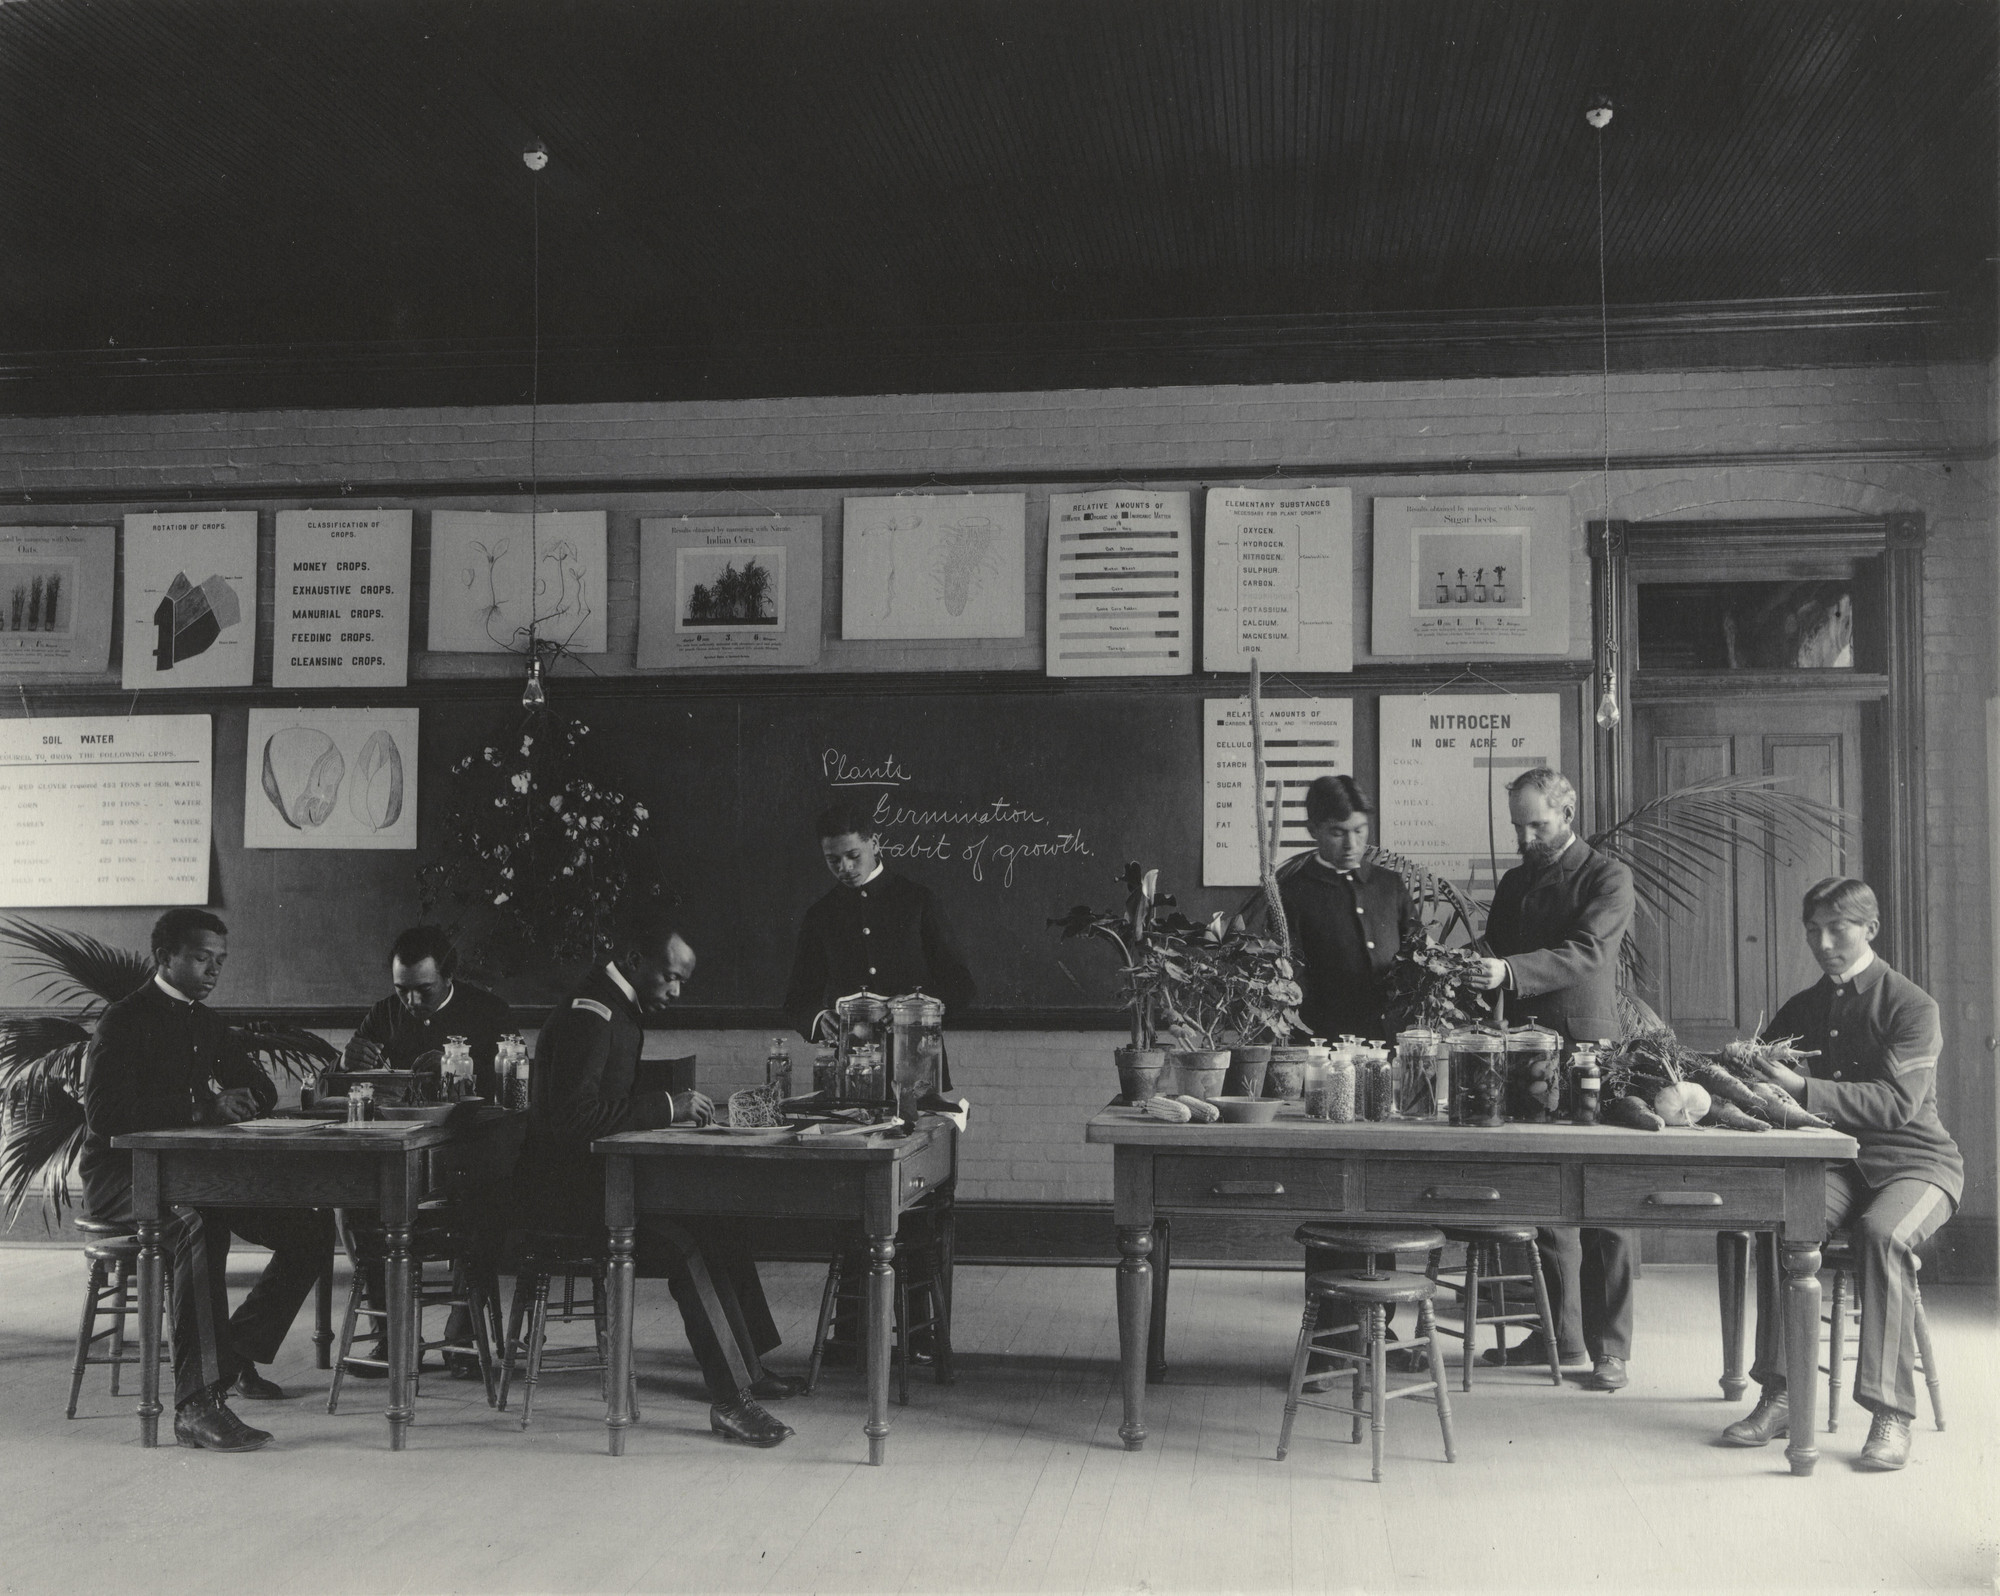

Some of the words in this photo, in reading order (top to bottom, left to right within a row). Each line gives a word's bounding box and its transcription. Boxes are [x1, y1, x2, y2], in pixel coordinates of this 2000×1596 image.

[1073, 503, 1108, 511] RELATIVE
[1225, 500, 1275, 508] ELEMENTARY
[1280, 500, 1331, 508] SUBSTANCES
[1443, 514, 1471, 525] Sugar
[706, 535, 732, 545] Indian
[293, 562, 327, 571] MONEY
[336, 562, 370, 571] CROPS.
[292, 585, 351, 595] EXHAUSTIVE
[360, 585, 394, 594] CROPS.
[292, 609, 341, 619] MANURIAL
[350, 609, 384, 618] CROPS.
[291, 633, 332, 642] FEEDING
[340, 633, 375, 642] CROPS.
[291, 657, 343, 666] CLEANSING
[352, 656, 385, 666] CROPS.
[1430, 714, 1511, 729] NITROGEN
[42, 735, 63, 745] SOIL
[80, 734, 115, 744] WATER
[1411, 738, 1422, 748] IN
[1435, 738, 1456, 748] ONE
[1469, 738, 1497, 748] ACRE
[1511, 738, 1525, 748] OF
[99, 750, 145, 758] FOLLOWING
[822, 748, 912, 781] Plants
[962, 834, 989, 882] of
[992, 828, 1094, 888] growth.
